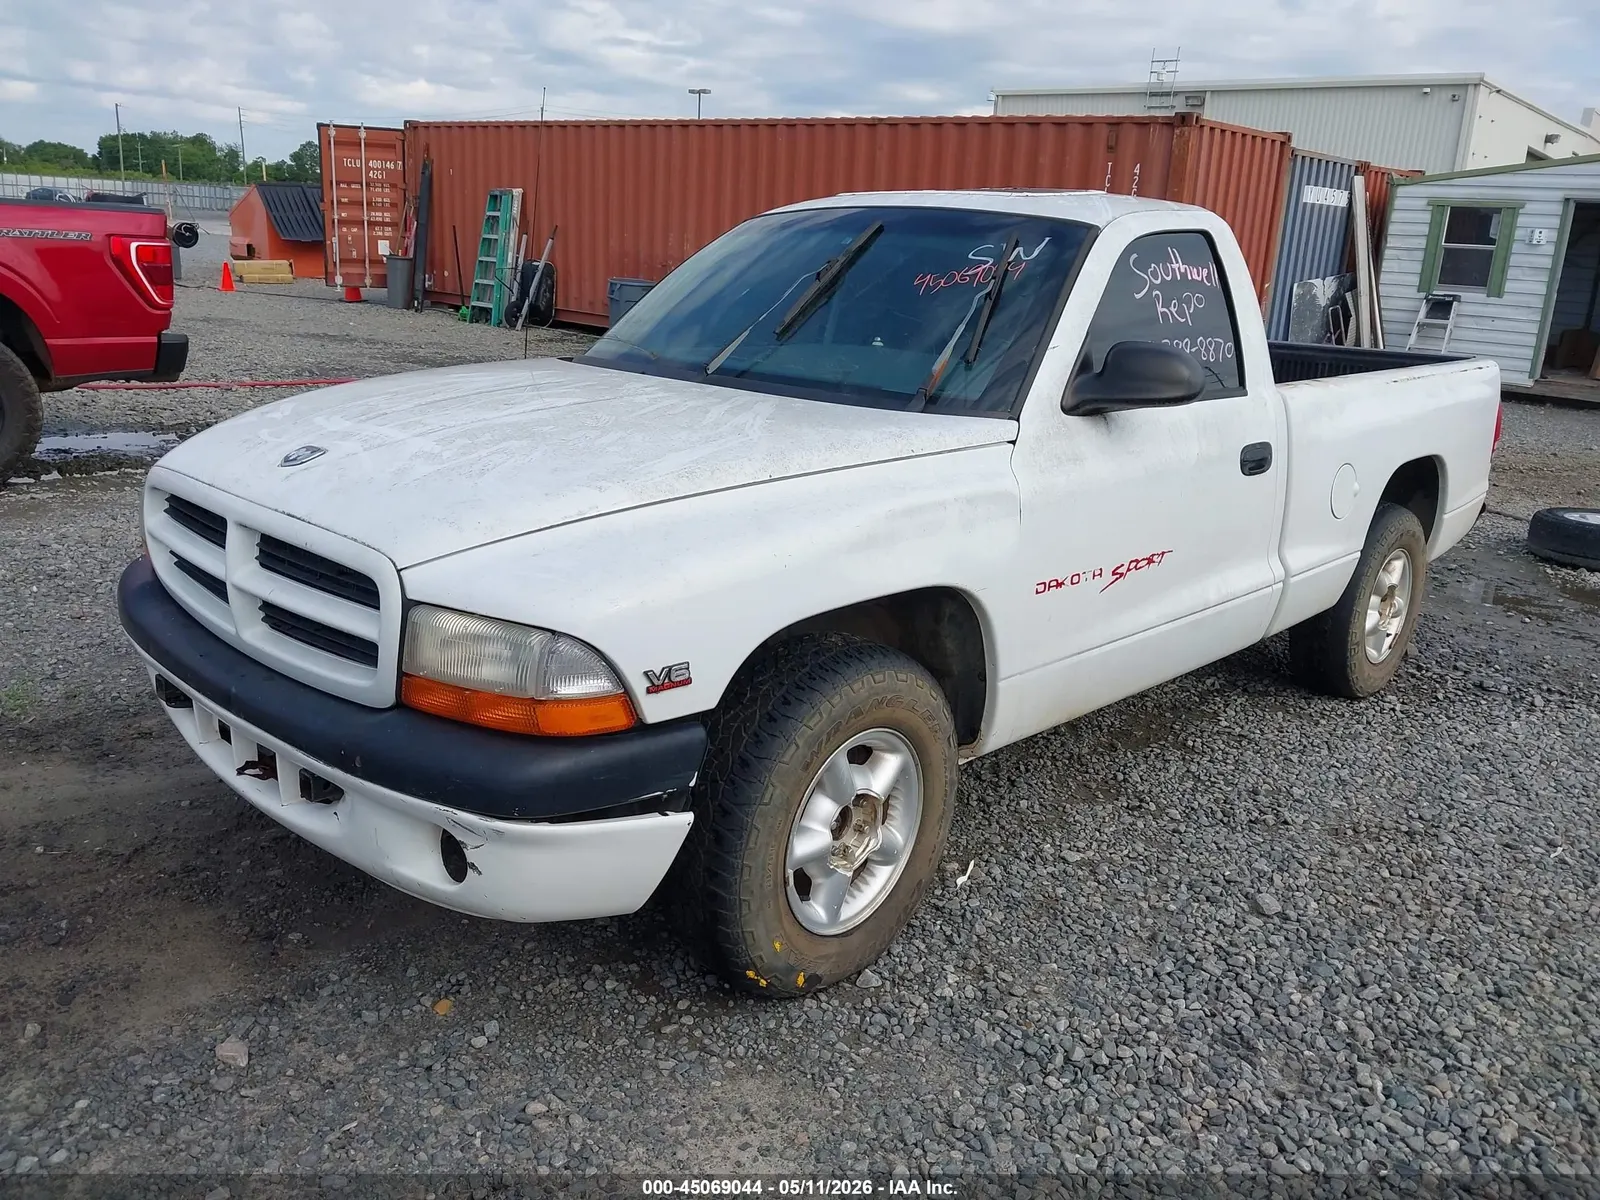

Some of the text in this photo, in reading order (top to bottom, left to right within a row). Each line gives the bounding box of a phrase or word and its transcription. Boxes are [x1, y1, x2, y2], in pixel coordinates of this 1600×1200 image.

[343, 158, 361, 167] TCLU
[368, 160, 395, 169] 400146
[368, 170, 386, 179] 42G1
[913, 262, 1027, 296] 4506904
[1129, 246, 1220, 299] Southwell
[1153, 289, 1206, 326] Repo
[1099, 549, 1174, 594] SPORT
[643, 661, 691, 686] V6
